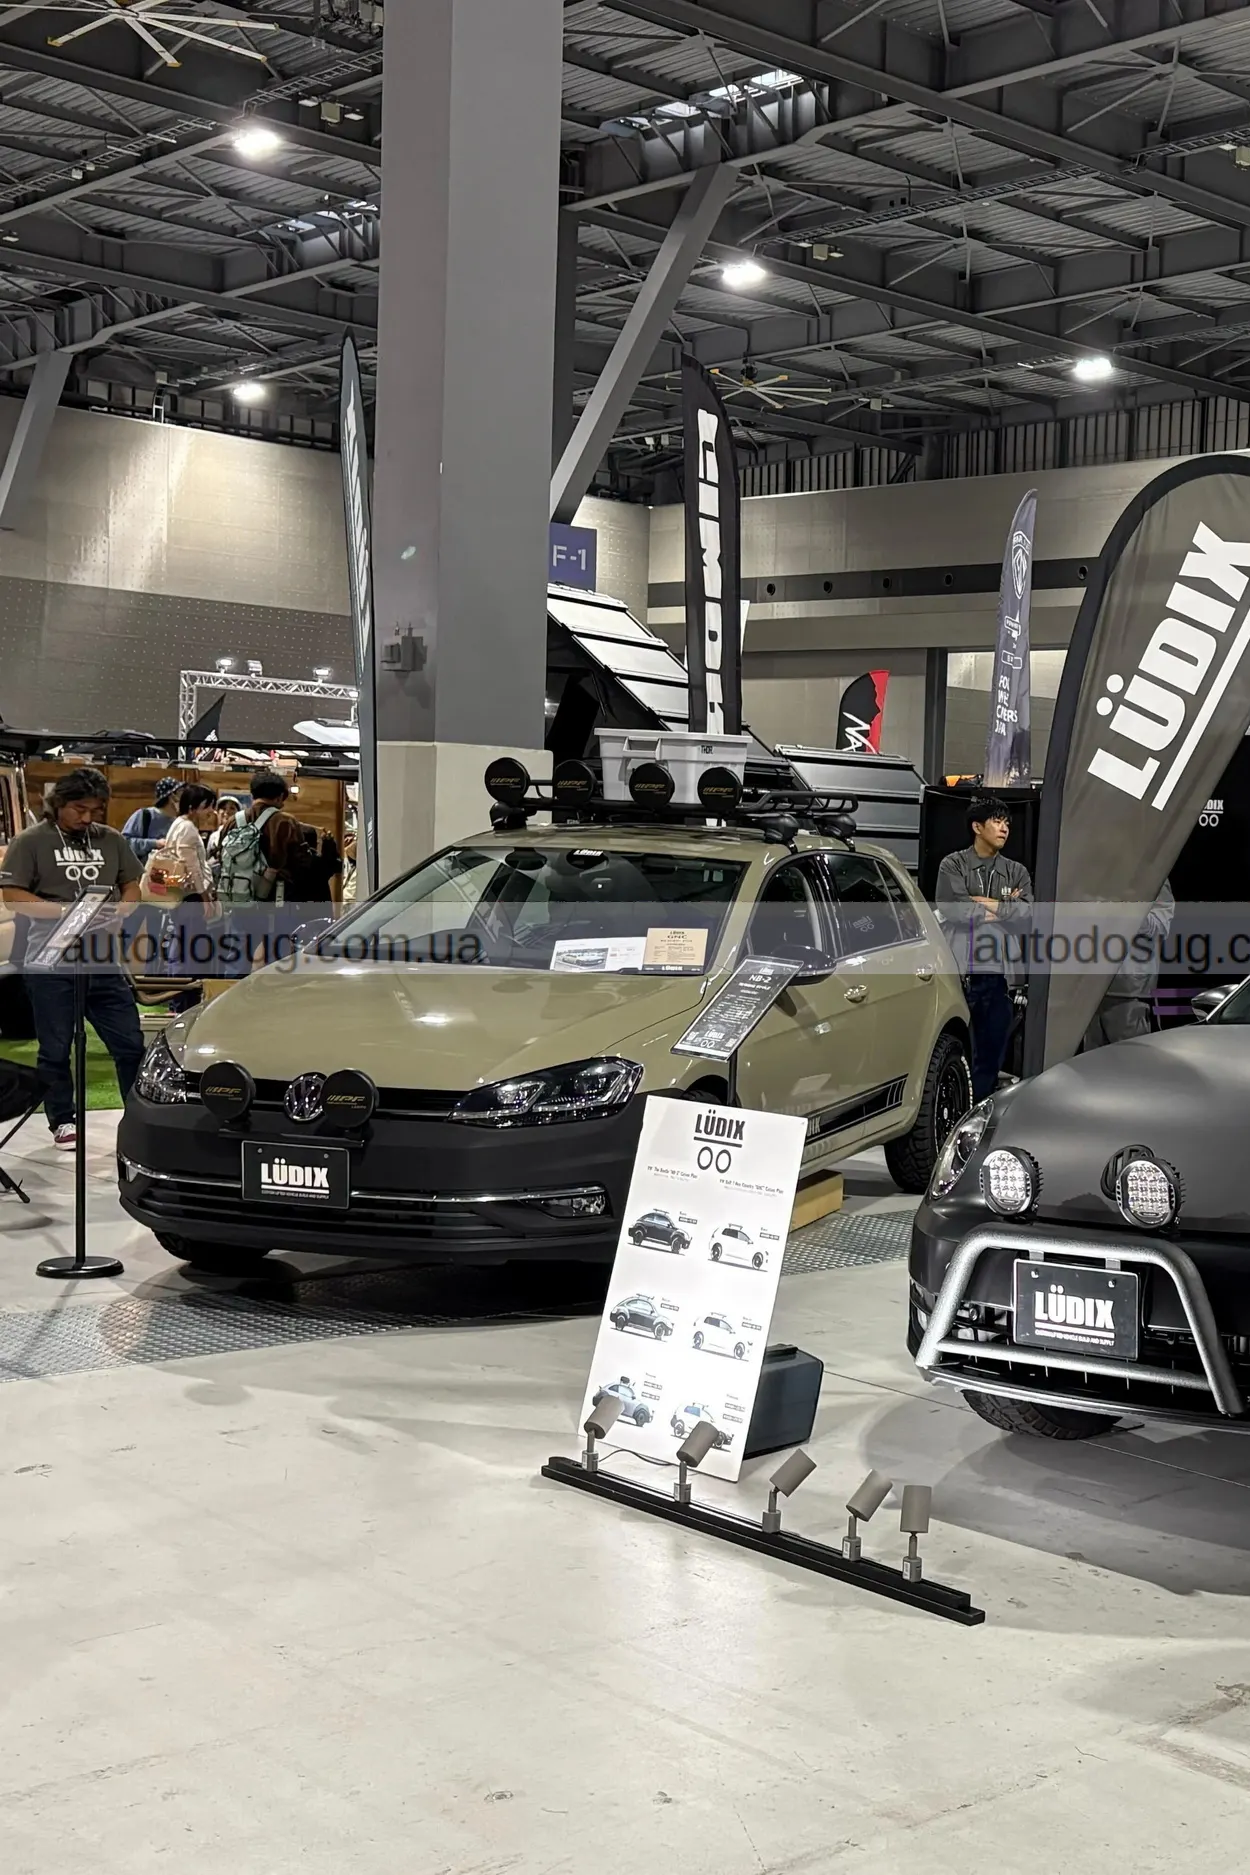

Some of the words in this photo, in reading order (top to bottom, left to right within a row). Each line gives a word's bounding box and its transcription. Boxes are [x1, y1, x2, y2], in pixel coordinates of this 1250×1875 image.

[553, 545, 586, 570] F-1
[695, 1109, 746, 1141] LÜDIX
[261, 1158, 329, 1188] LÜDIX
[1035, 1284, 1115, 1330] LÜDIX
